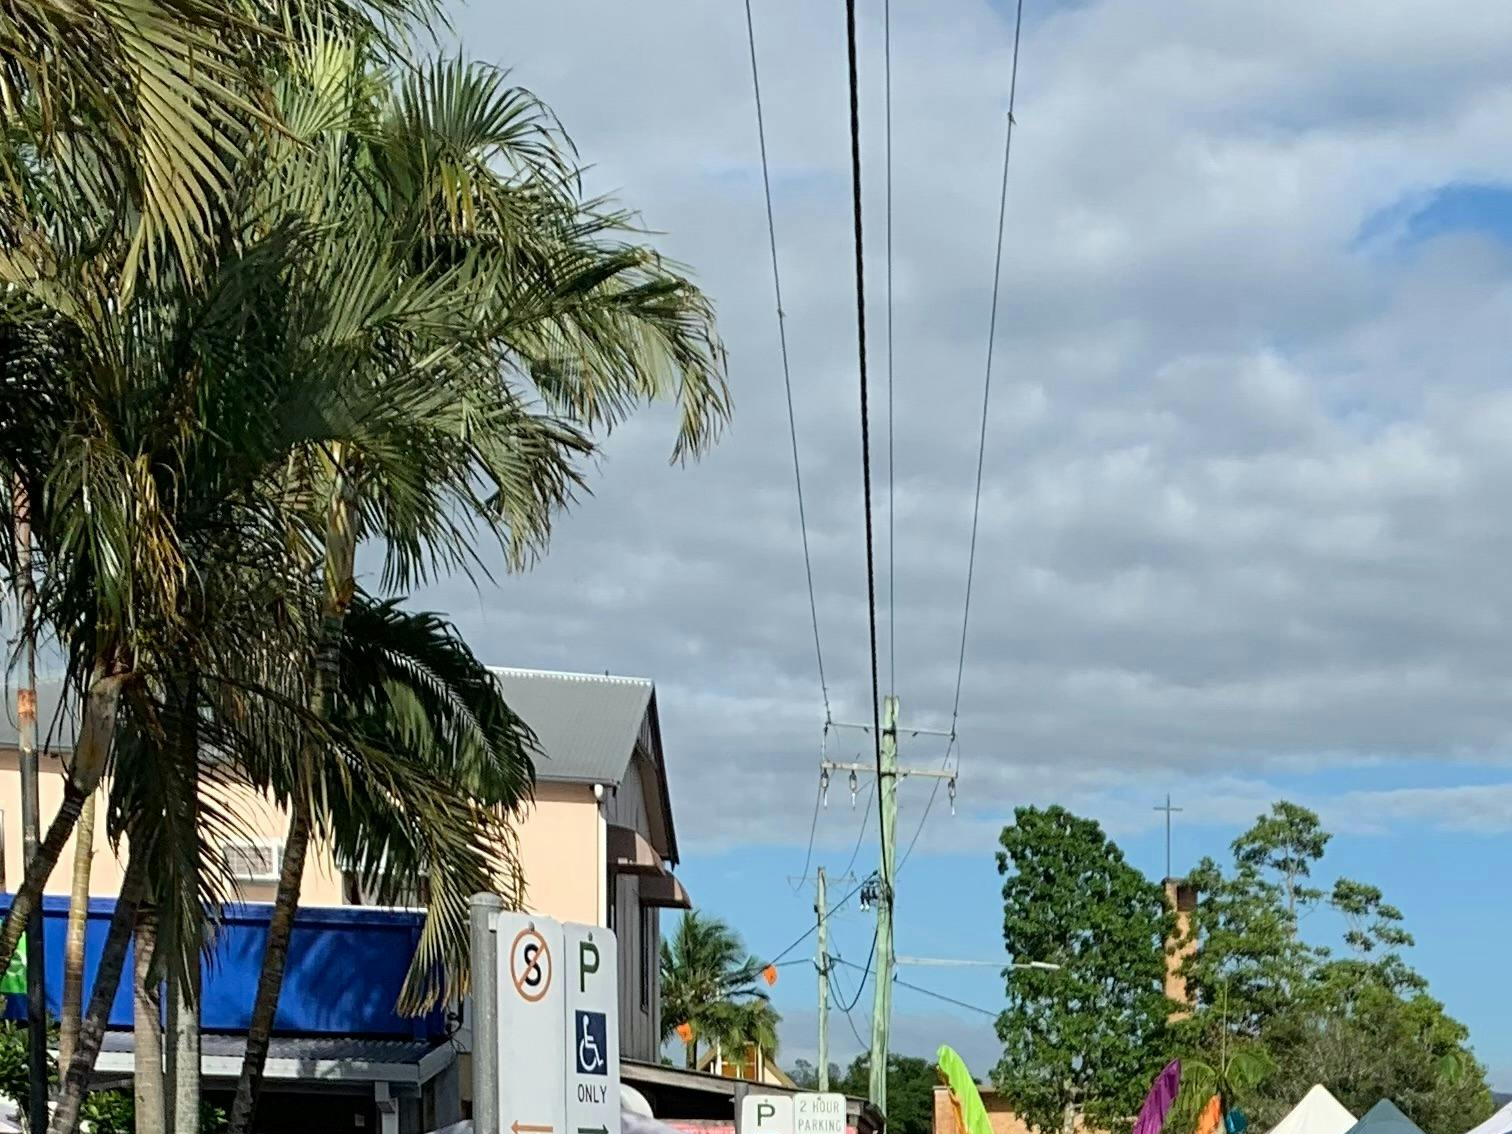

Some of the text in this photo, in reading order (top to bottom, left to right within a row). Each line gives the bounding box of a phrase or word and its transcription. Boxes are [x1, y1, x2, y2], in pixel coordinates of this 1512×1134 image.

[523, 943, 542, 987] S
[580, 940, 600, 993] P
[577, 1083, 607, 1104] ONLY
[757, 1103, 775, 1127] P
[799, 1101, 840, 1113] 2 HOUR
[798, 1119, 842, 1132] PARKING
